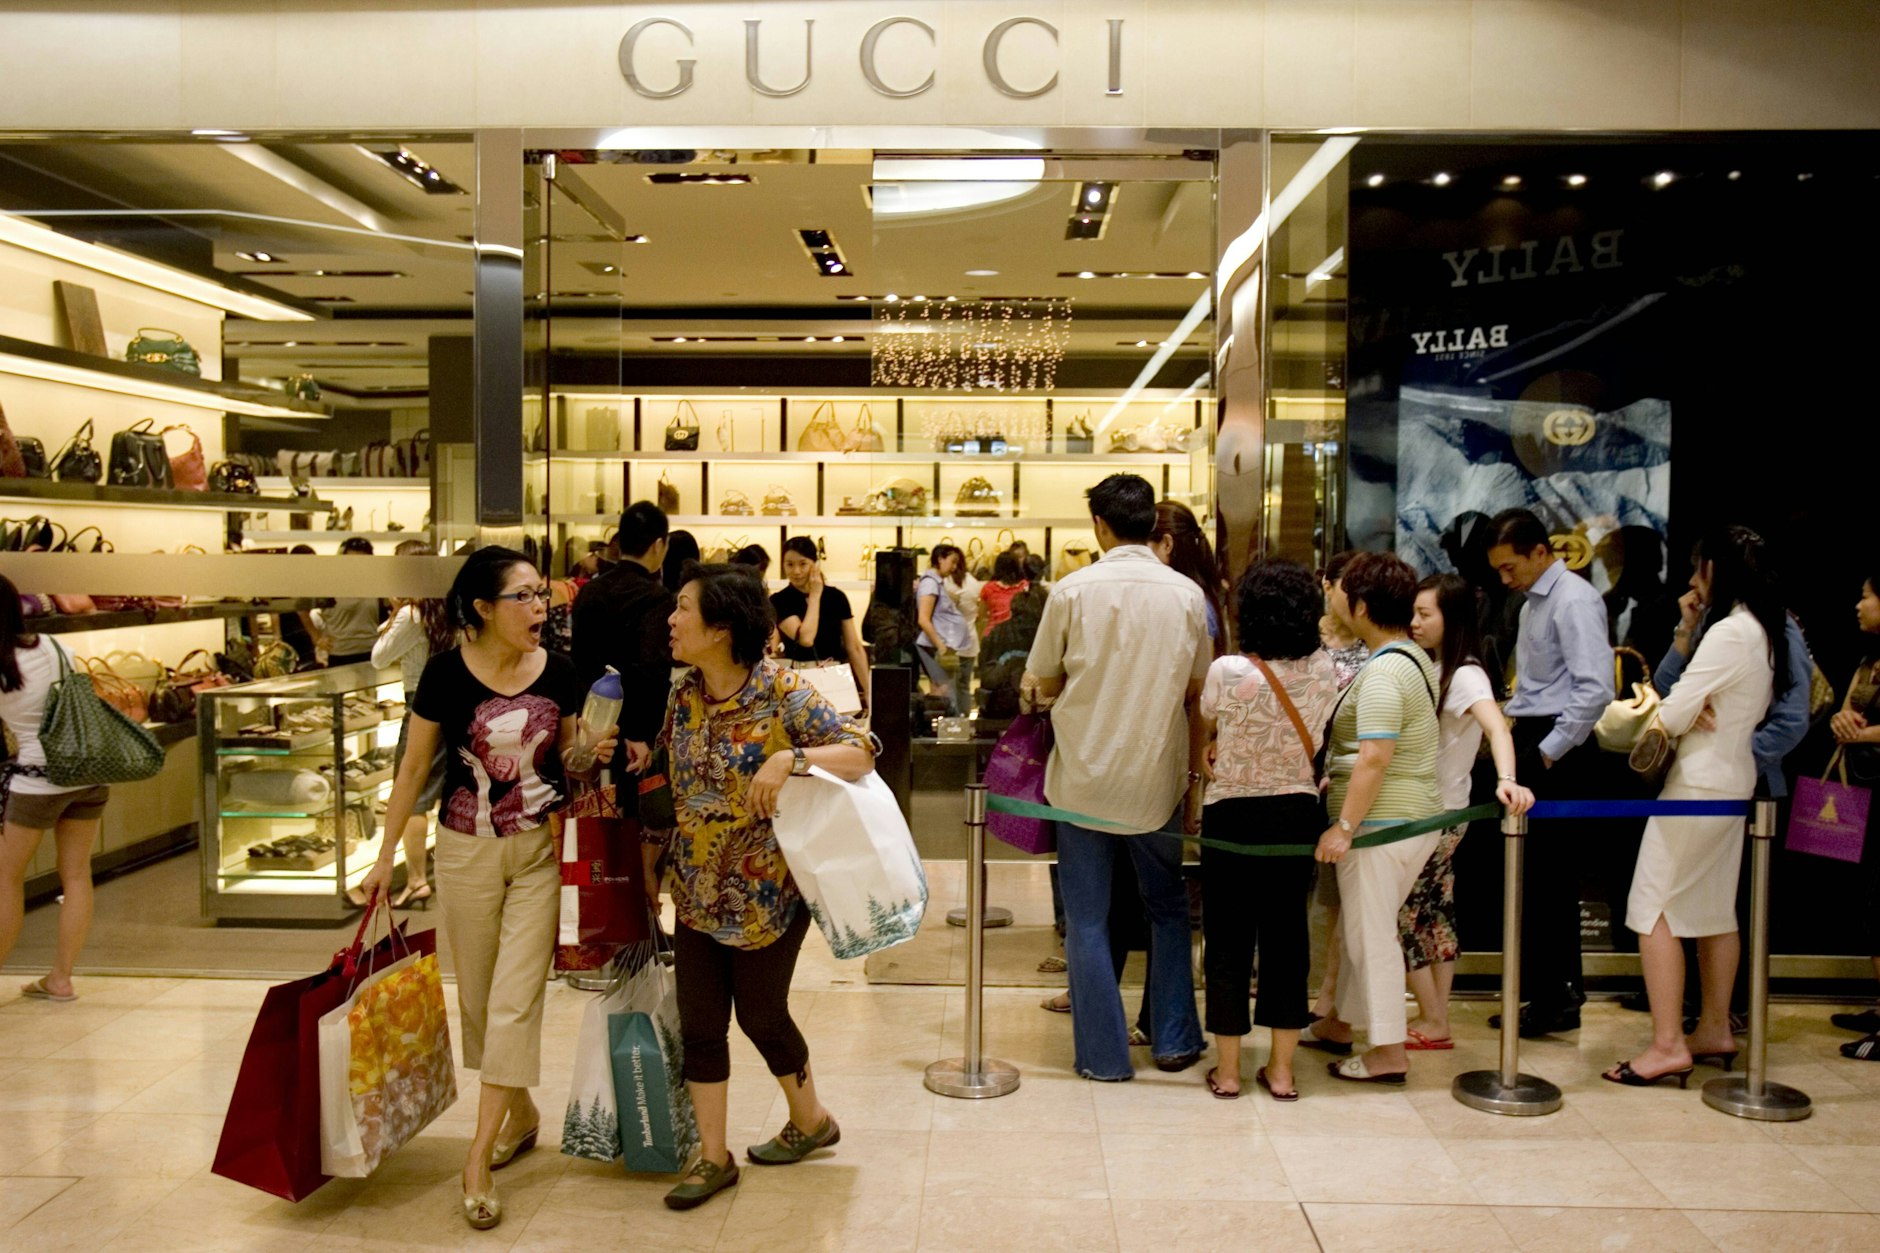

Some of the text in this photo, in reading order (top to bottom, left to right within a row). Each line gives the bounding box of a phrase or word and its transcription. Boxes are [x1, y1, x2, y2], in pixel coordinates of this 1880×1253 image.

[618, 16, 1124, 99] GUCCI
[631, 1045, 643, 1073] better.
[635, 1082, 647, 1105] Make
[637, 1106, 653, 1147] Timberland
